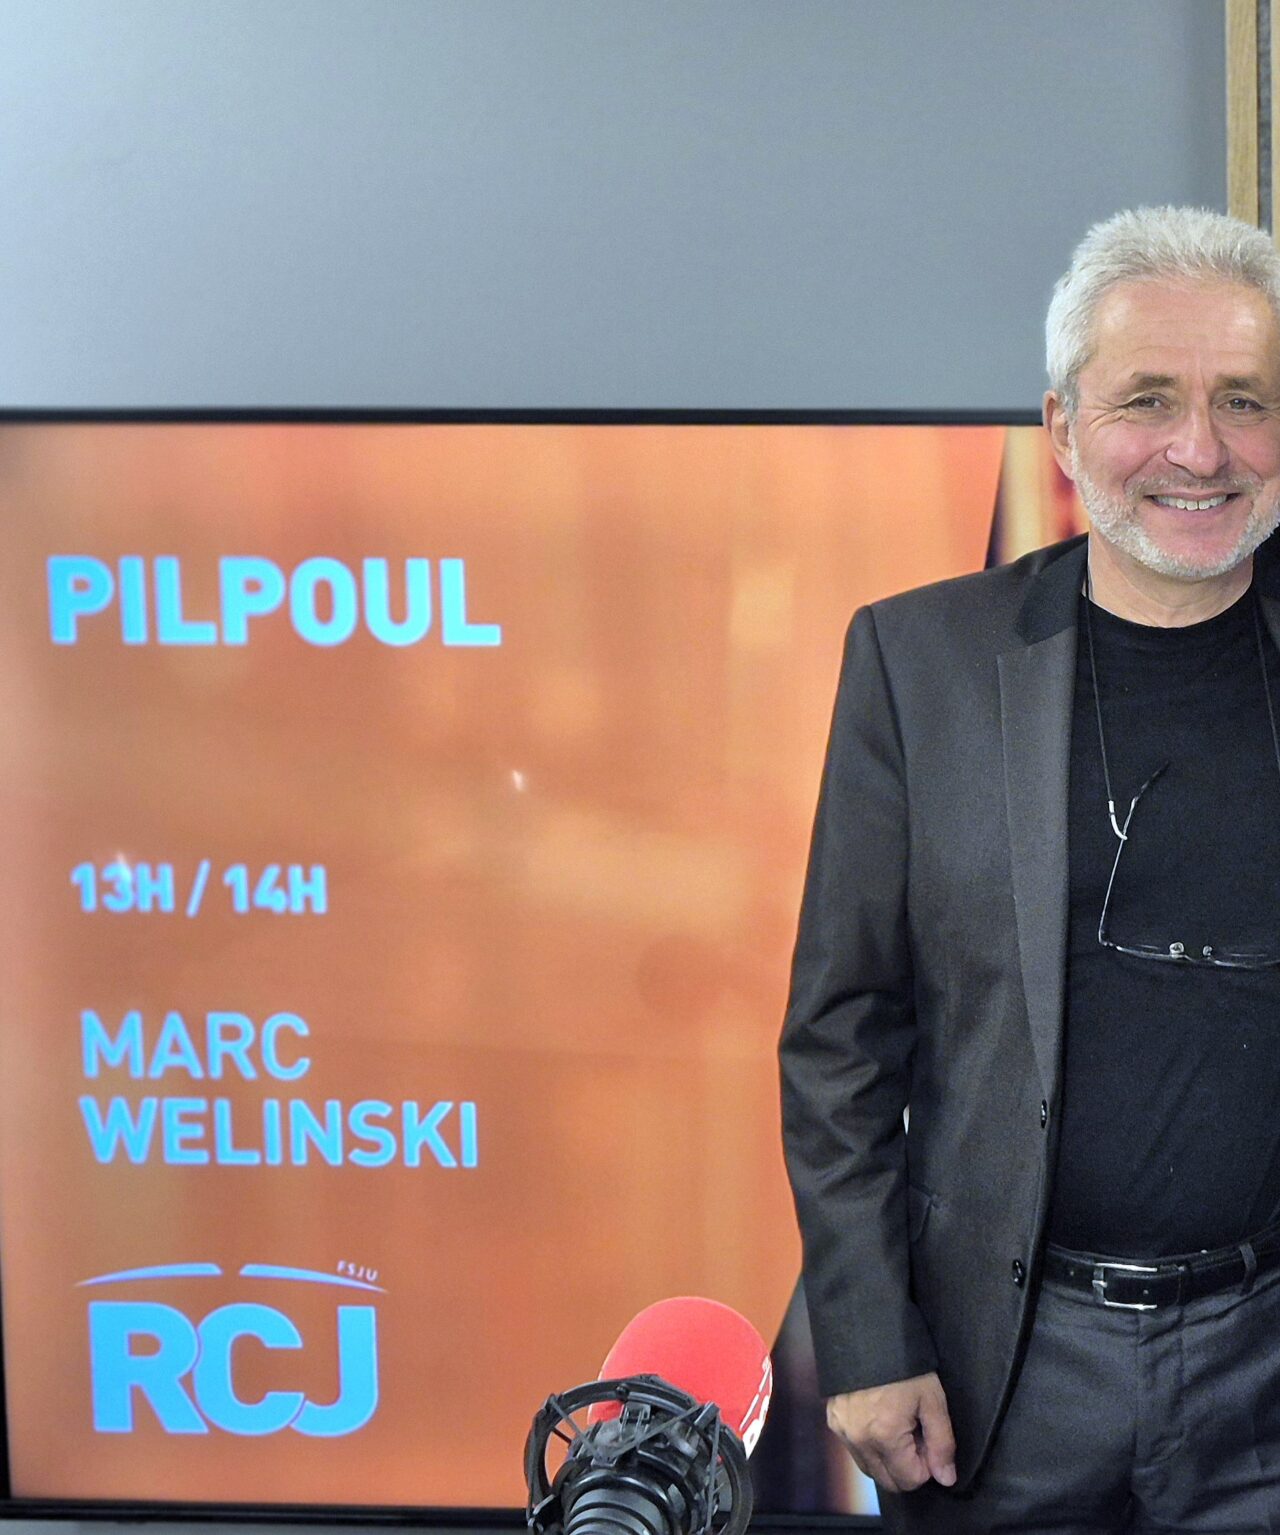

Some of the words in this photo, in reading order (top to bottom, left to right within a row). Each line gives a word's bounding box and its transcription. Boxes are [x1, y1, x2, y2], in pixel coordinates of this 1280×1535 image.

[47, 555, 502, 647] PILPOUL
[71, 861, 175, 914] 13H
[187, 860, 211, 917] /
[223, 864, 328, 915] 14H
[80, 1009, 311, 1081] MARC
[79, 1095, 479, 1169] WELINSKI
[336, 1260, 378, 1282] FSJU
[88, 1300, 380, 1438] RCJ
